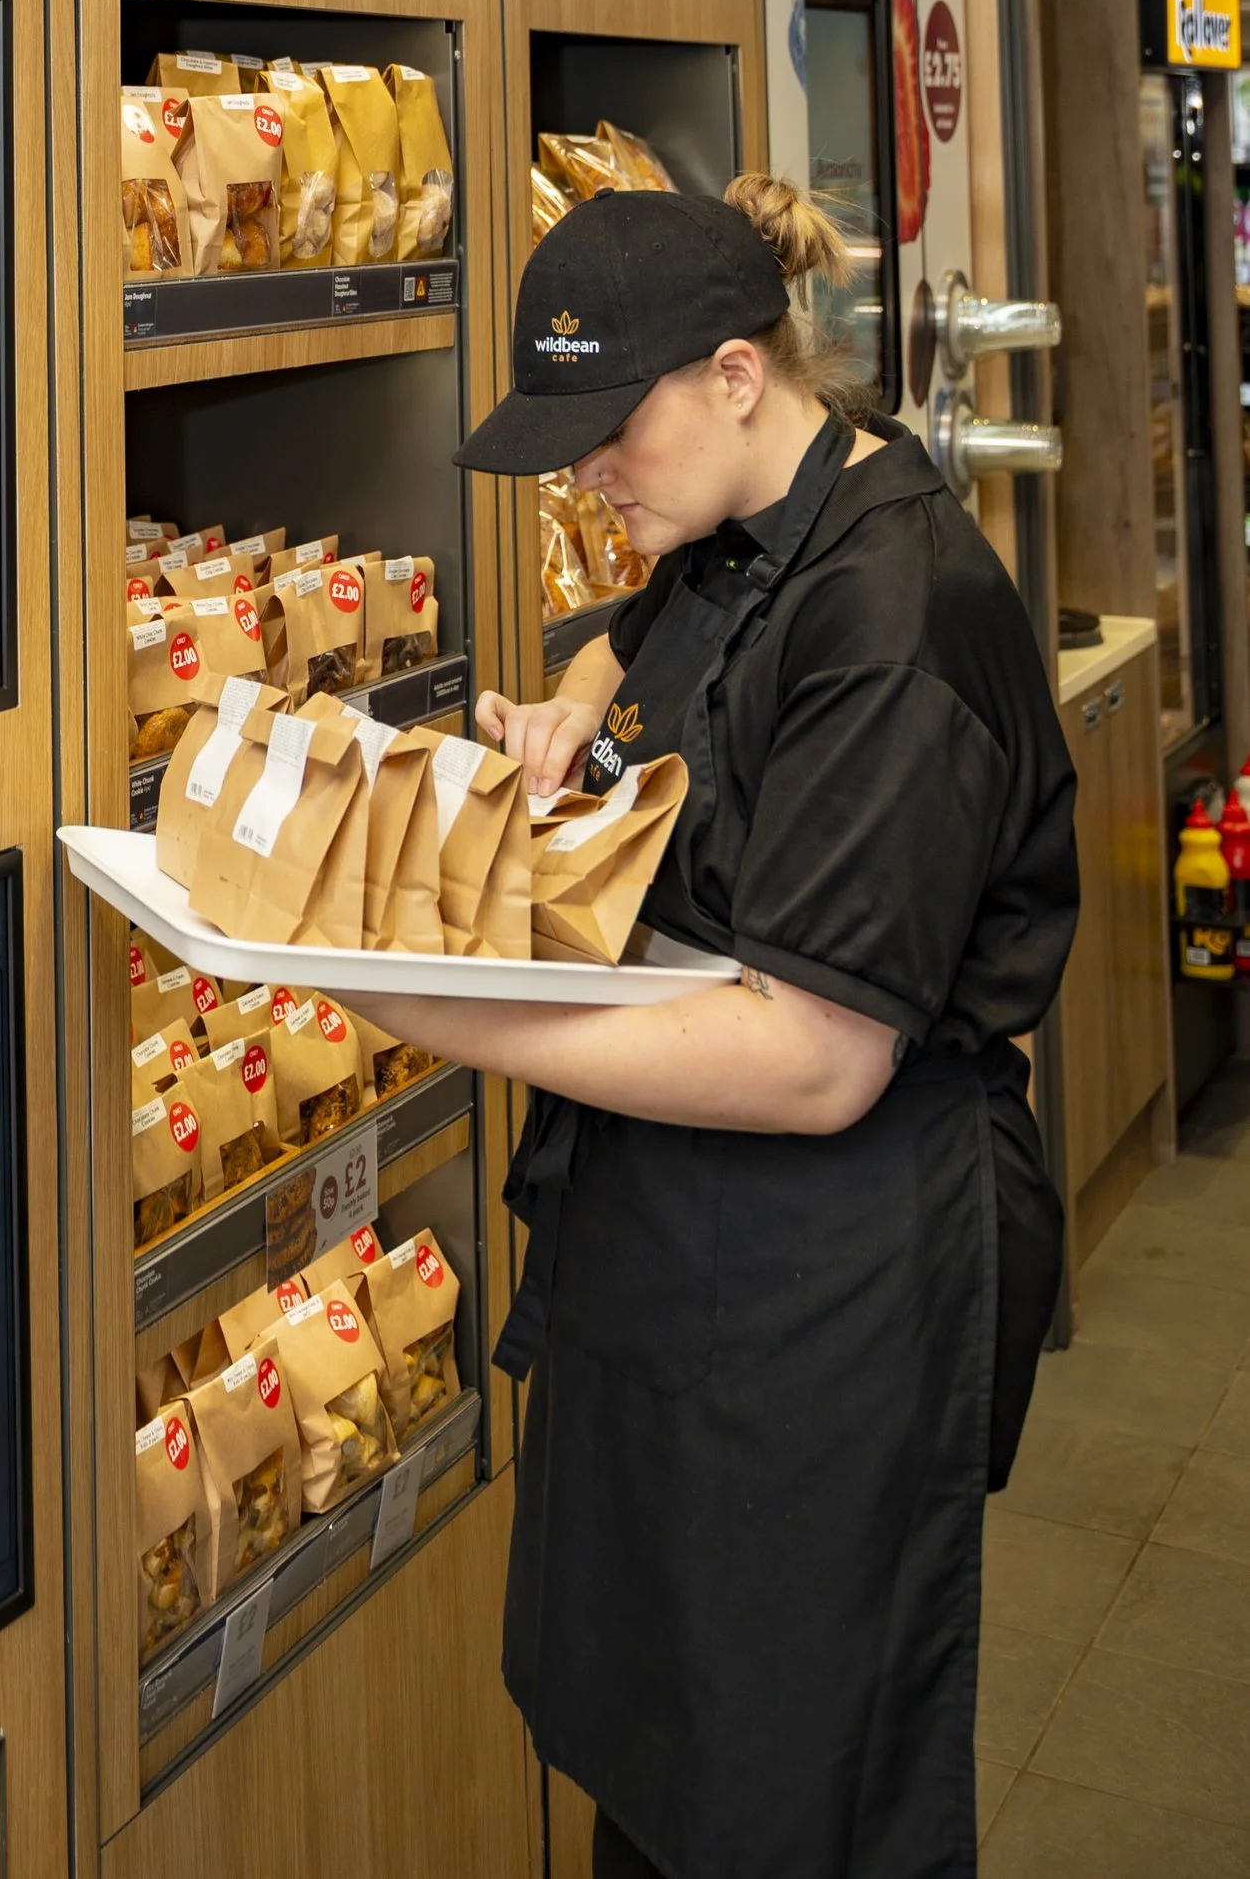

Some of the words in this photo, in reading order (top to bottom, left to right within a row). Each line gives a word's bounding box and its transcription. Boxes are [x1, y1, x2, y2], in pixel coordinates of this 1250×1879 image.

[924, 50, 961, 89] £2.75
[256, 116, 282, 139] £2.00
[534, 336, 600, 353] wildbean
[551, 353, 578, 362] cafe
[331, 583, 359, 602] £2.00
[412, 581, 427, 605] £2.00
[240, 610, 259, 633] £2.00
[173, 647, 197, 669] £2.00
[131, 960, 144, 979] £2.00
[196, 987, 215, 1012] £2.00
[273, 1001, 298, 1021] £2.00
[321, 1011, 342, 1034] £2.00
[244, 1058, 266, 1082] £2.00
[174, 1114, 197, 1142] £2.00
[344, 1154, 367, 1198] £2
[354, 1230, 373, 1257] £2.00
[418, 1254, 440, 1282] £2.00
[330, 1314, 357, 1331] £2.00
[260, 1369, 278, 1400] £2.00
[168, 1428, 187, 1462] £2.00
